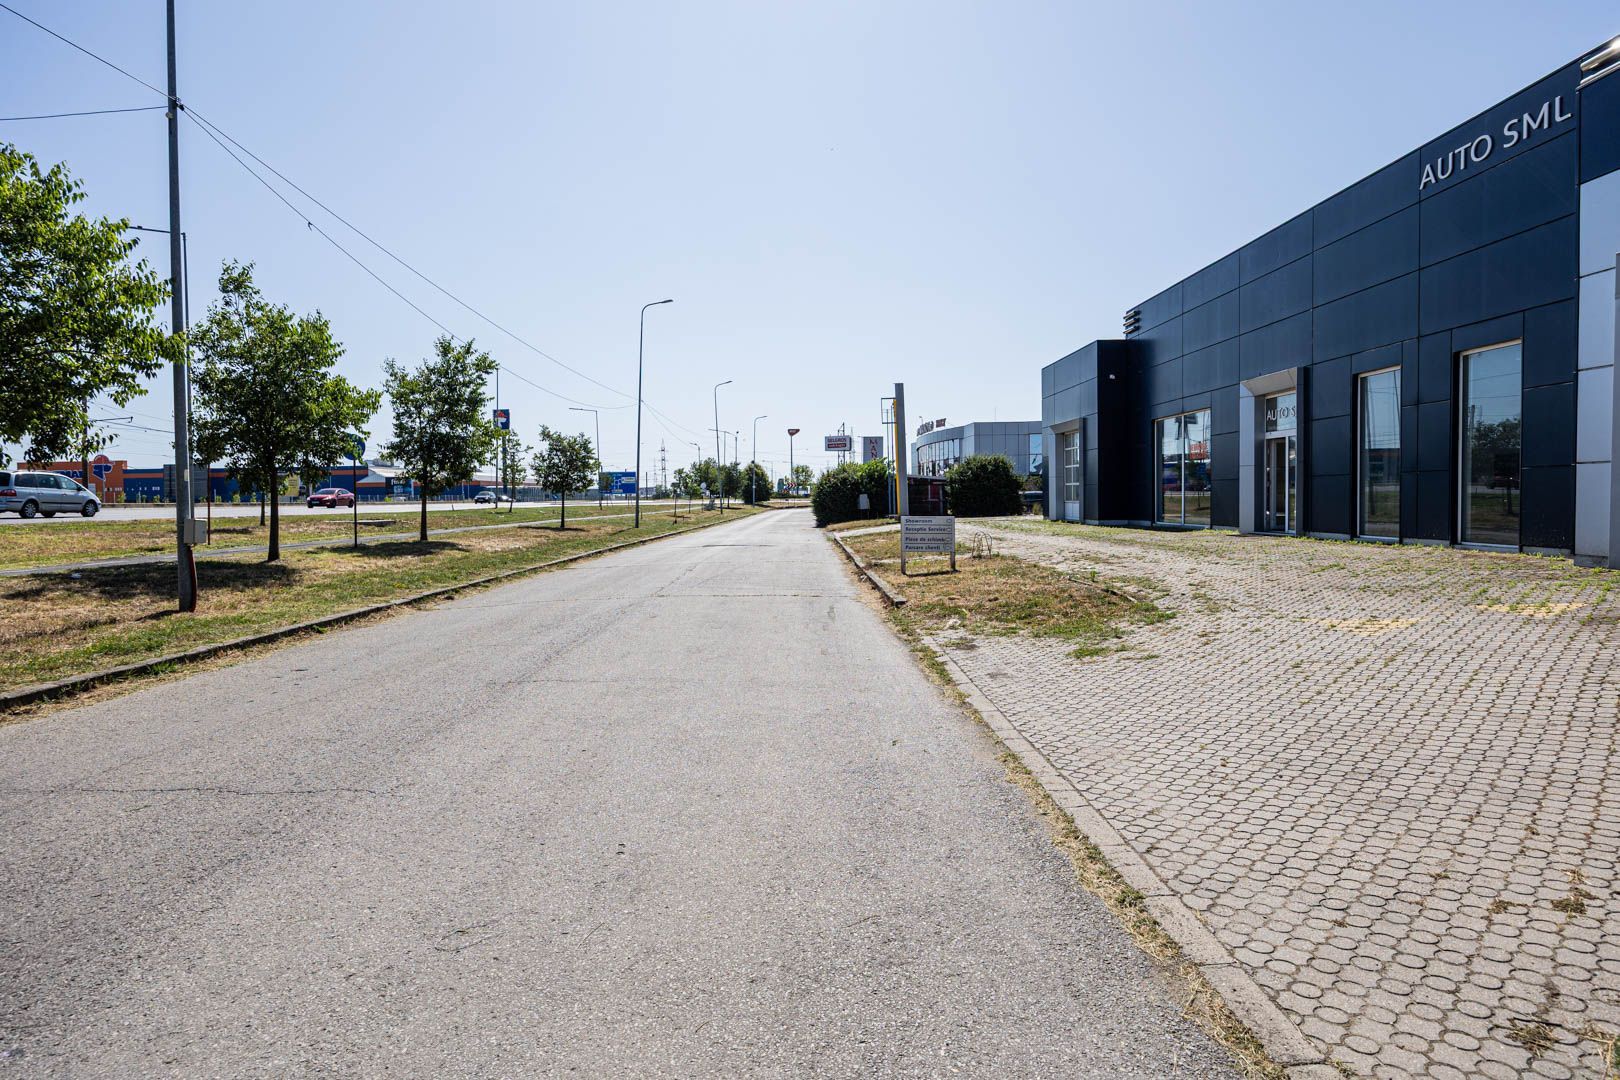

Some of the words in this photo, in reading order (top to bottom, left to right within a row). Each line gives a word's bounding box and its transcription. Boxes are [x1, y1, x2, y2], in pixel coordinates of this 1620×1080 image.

[1419, 134, 1494, 191] AUTO
[1503, 95, 1572, 149] SML
[1267, 401, 1289, 421] AUTO
